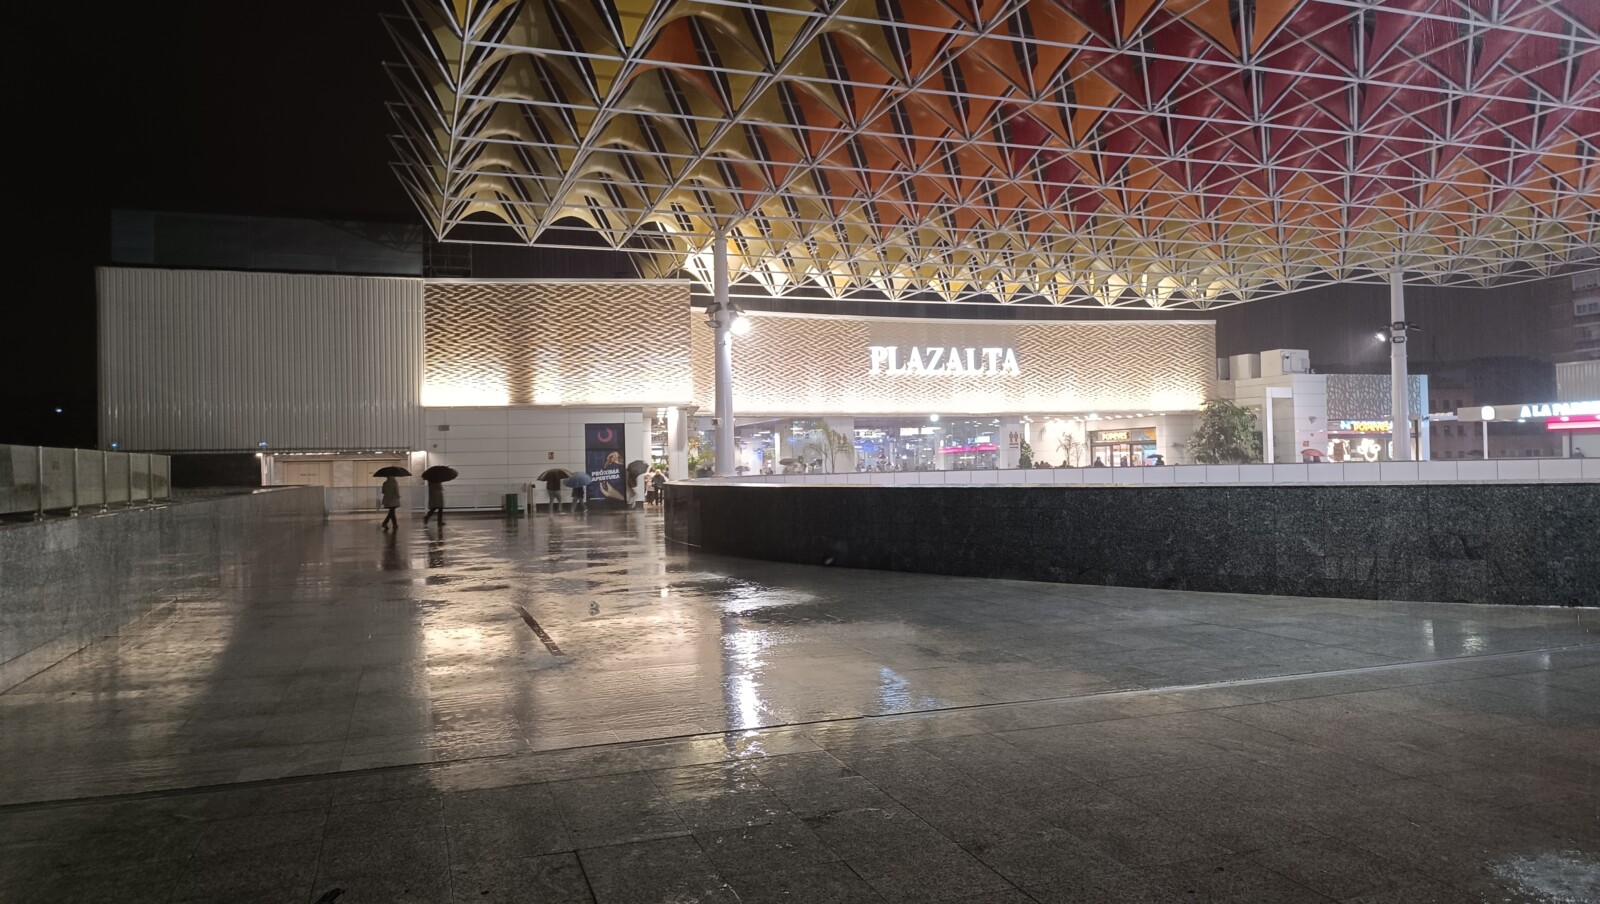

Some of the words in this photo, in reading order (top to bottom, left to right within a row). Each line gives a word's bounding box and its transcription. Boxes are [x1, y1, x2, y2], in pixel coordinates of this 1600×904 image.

[869, 346, 1021, 374] PLAZALTA
[591, 469, 620, 477] PRÓXIMA
[591, 474, 620, 482] APERTURA
